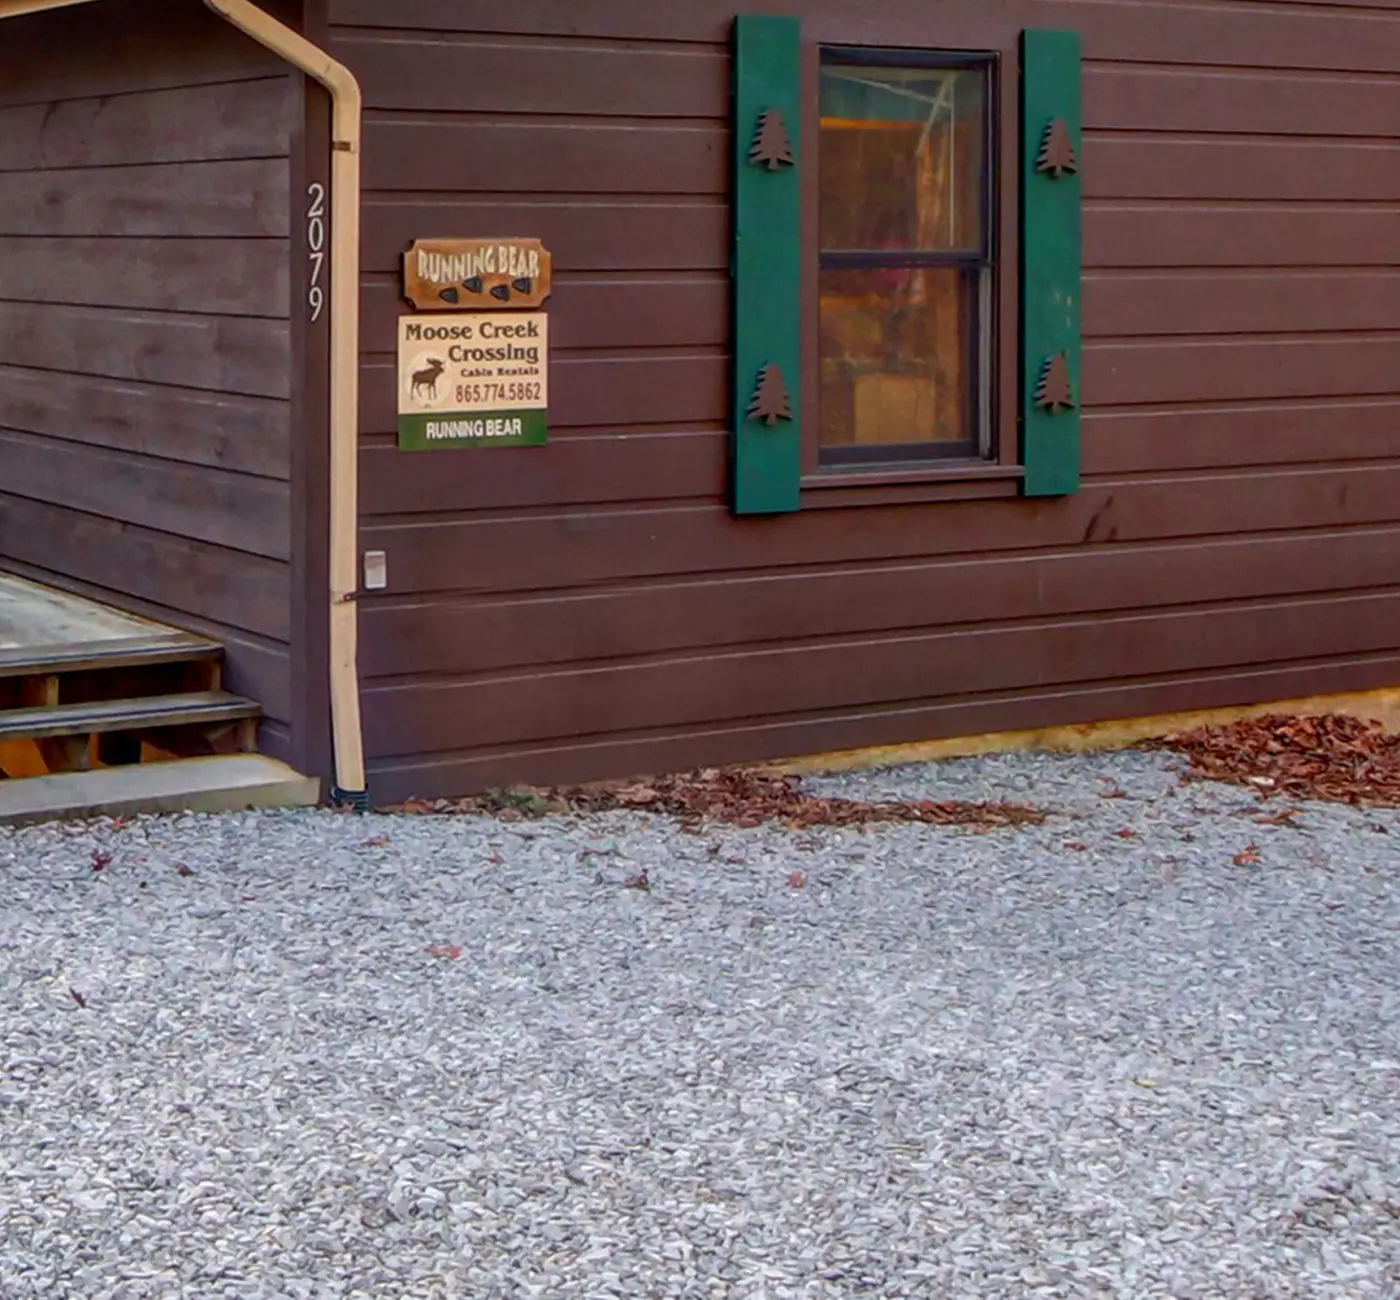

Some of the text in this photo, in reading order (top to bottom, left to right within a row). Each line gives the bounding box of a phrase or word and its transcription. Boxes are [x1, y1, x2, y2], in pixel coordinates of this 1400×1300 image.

[308, 183, 324, 322] 2079
[418, 246, 540, 283] RUNNING BEAR
[405, 321, 539, 341] Moose Creek
[448, 344, 539, 364] Crossing
[461, 366, 539, 377] Cabin Rentals
[455, 382, 541, 403] 865.774.5862
[426, 418, 521, 439] RUNNING BEAR
